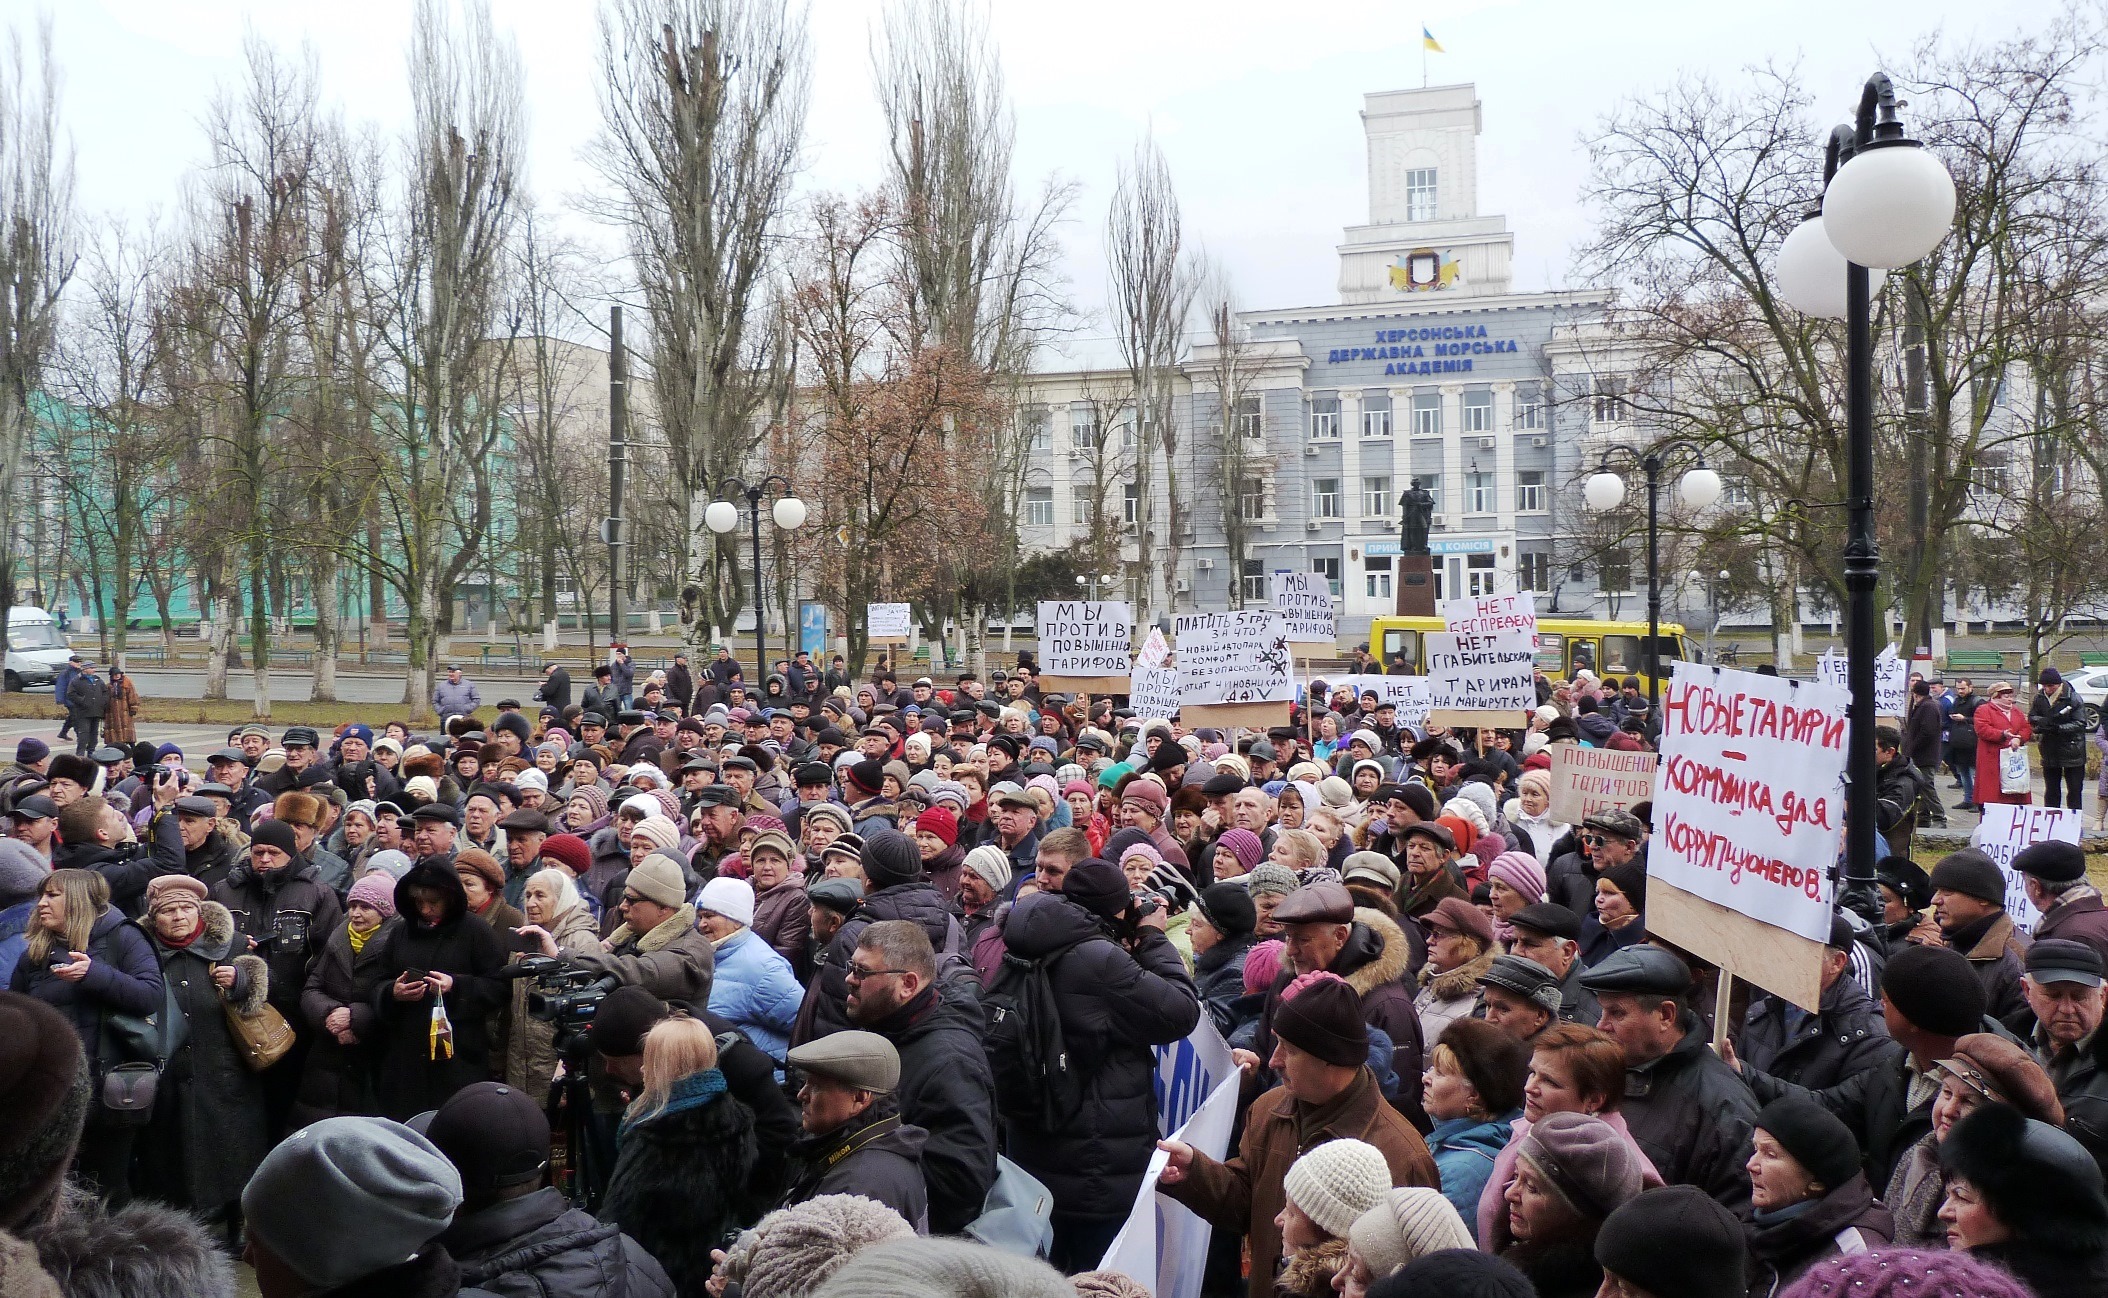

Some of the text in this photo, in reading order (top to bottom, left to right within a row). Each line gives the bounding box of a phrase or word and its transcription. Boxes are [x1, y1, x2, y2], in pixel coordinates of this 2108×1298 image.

[1376, 325, 1487, 343] ХЕРСОНСЬКА
[1328, 340, 1518, 364] ДЕРЖАВНА МОРСЬКА
[1385, 359, 1473, 375] АКАДЕМІЯ
[1445, 541, 1489, 551] КОМІСІЯ
[1285, 575, 1308, 591] МЫ
[1279, 594, 1327, 607] ПРОТИВ
[1477, 597, 1515, 617] НЕТ
[1056, 603, 1102, 621] МЫ
[1046, 622, 1126, 638] ПРОТИВ
[1176, 612, 1272, 632] ПЛАТИТЬ 5 ГРН
[1449, 614, 1535, 633] БЕСПРЕДЕЛУ
[1212, 624, 1267, 638] ЗА ЧТО?
[1052, 639, 1131, 654] ПОВЫШЕНИЯ
[1186, 642, 1220, 654] НОВЫЙ
[1222, 641, 1264, 651] АВТОПАРК
[1456, 635, 1497, 651] НЕТ
[1049, 656, 1126, 670] ТАРИФОВ
[1191, 653, 1239, 665] КОМФОРТ
[1432, 652, 1532, 669] ГРАБИТЕЛЬСКИМ
[1885, 660, 1904, 672] ЗА
[1146, 670, 1177, 686] МЫ
[1191, 664, 1261, 676] БЕЗОПАСНОСТЬ
[1137, 683, 1180, 696] ПРОТИ
[1184, 678, 1287, 692] ОТКАТ ЧИНОВНИКАМ
[1387, 686, 1413, 697] НЕТ
[1445, 674, 1532, 695] ТАРИФАМ
[1434, 695, 1532, 709] НА МАРШРУТКУ
[1665, 682, 1746, 738] НОВЫЕ
[1131, 706, 1174, 719] ТАРИФО
[1665, 753, 1775, 816] КОРМУШКА
[2009, 807, 2063, 846] НЕТ
[828, 1144, 851, 1165] Nikon
